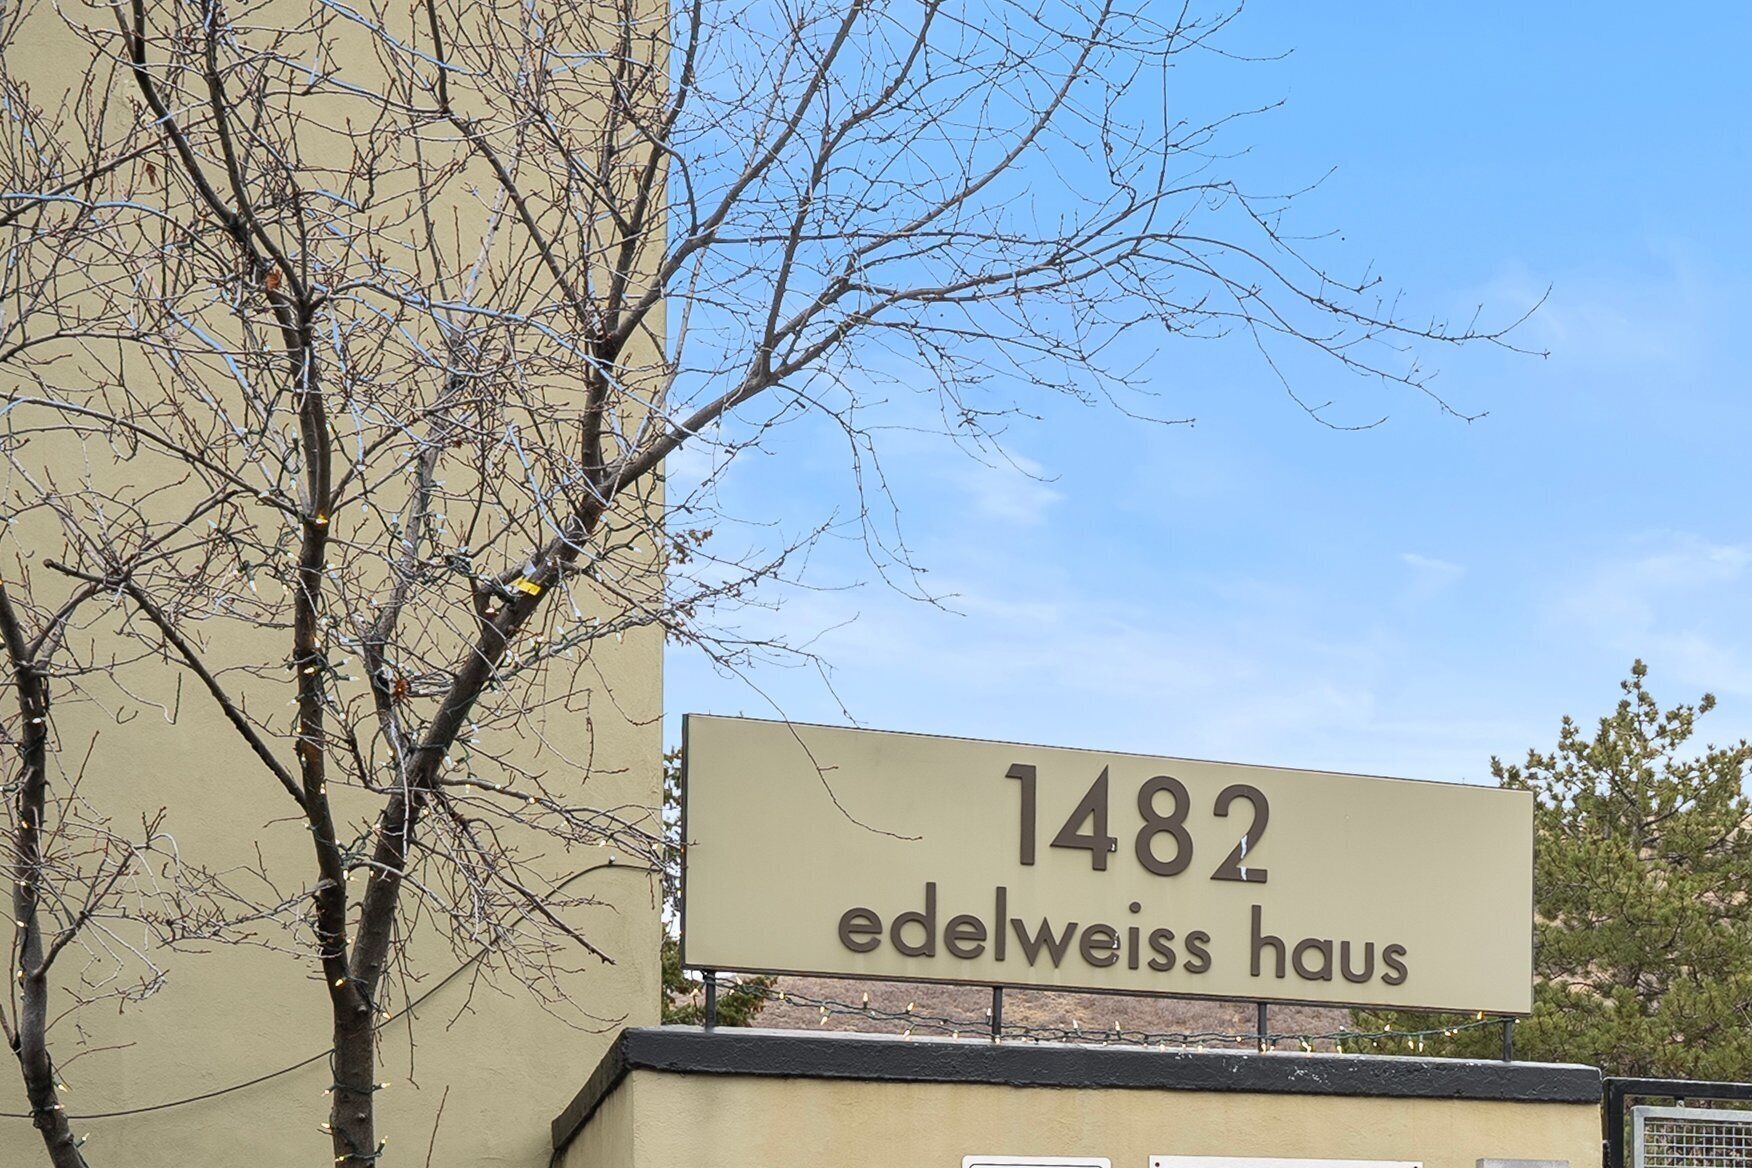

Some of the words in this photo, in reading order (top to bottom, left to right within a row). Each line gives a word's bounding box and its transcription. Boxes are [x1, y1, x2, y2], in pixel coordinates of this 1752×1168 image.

[1004, 762, 1270, 884] 1482
[838, 882, 1212, 973] edelweiss
[1250, 904, 1409, 986] haus
